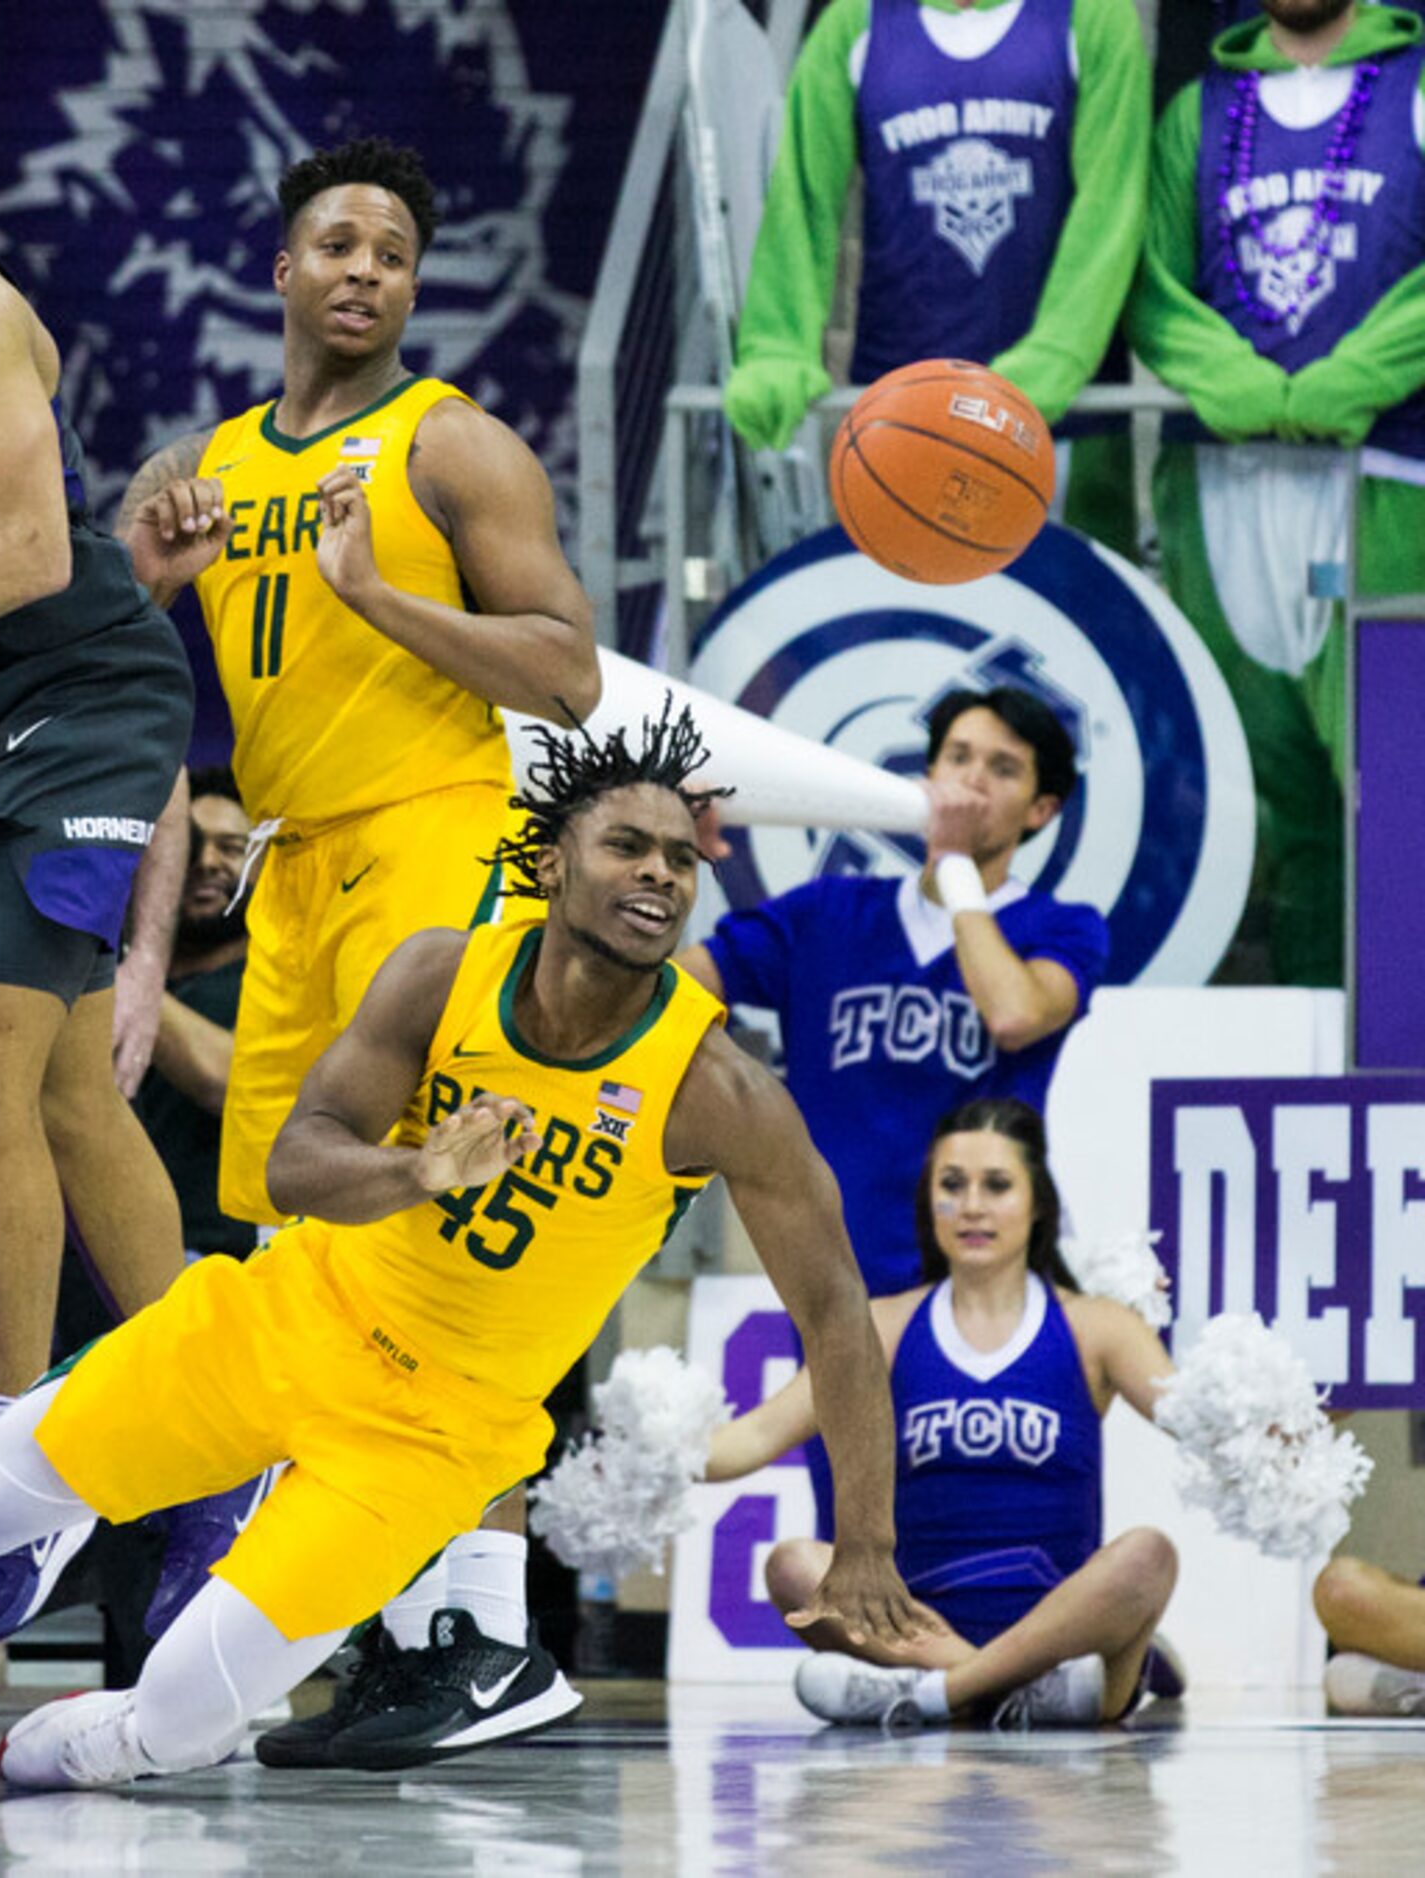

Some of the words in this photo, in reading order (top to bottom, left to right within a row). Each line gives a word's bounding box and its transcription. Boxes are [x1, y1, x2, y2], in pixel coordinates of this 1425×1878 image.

[881, 102, 959, 152] FROG
[963, 98, 1054, 139] ARMY
[226, 491, 322, 562] EAR
[251, 573, 290, 679] 11
[831, 985, 997, 1081] TCU
[433, 1169, 559, 1271] 45
[904, 1398, 1061, 1467] TCU
